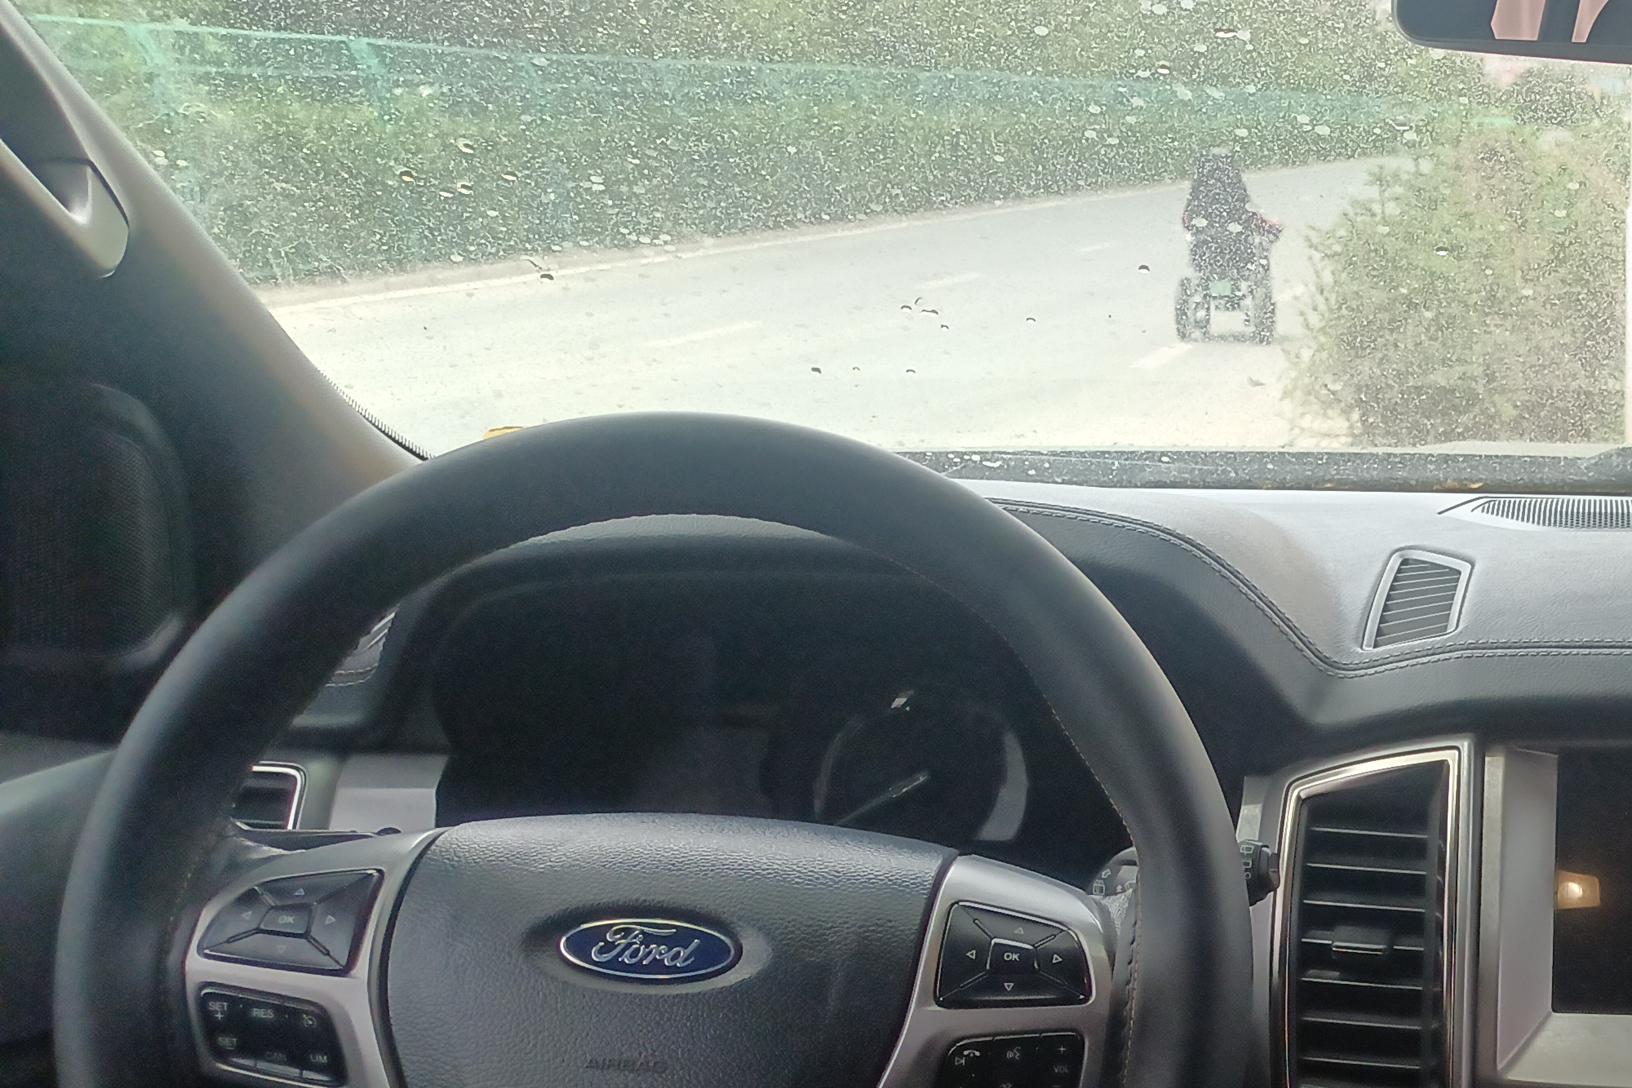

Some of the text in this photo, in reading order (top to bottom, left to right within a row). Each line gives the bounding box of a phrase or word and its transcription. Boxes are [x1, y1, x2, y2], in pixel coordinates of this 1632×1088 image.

[277, 914, 295, 924] OK
[591, 924, 701, 968] Ford
[1003, 952, 1021, 962] OK
